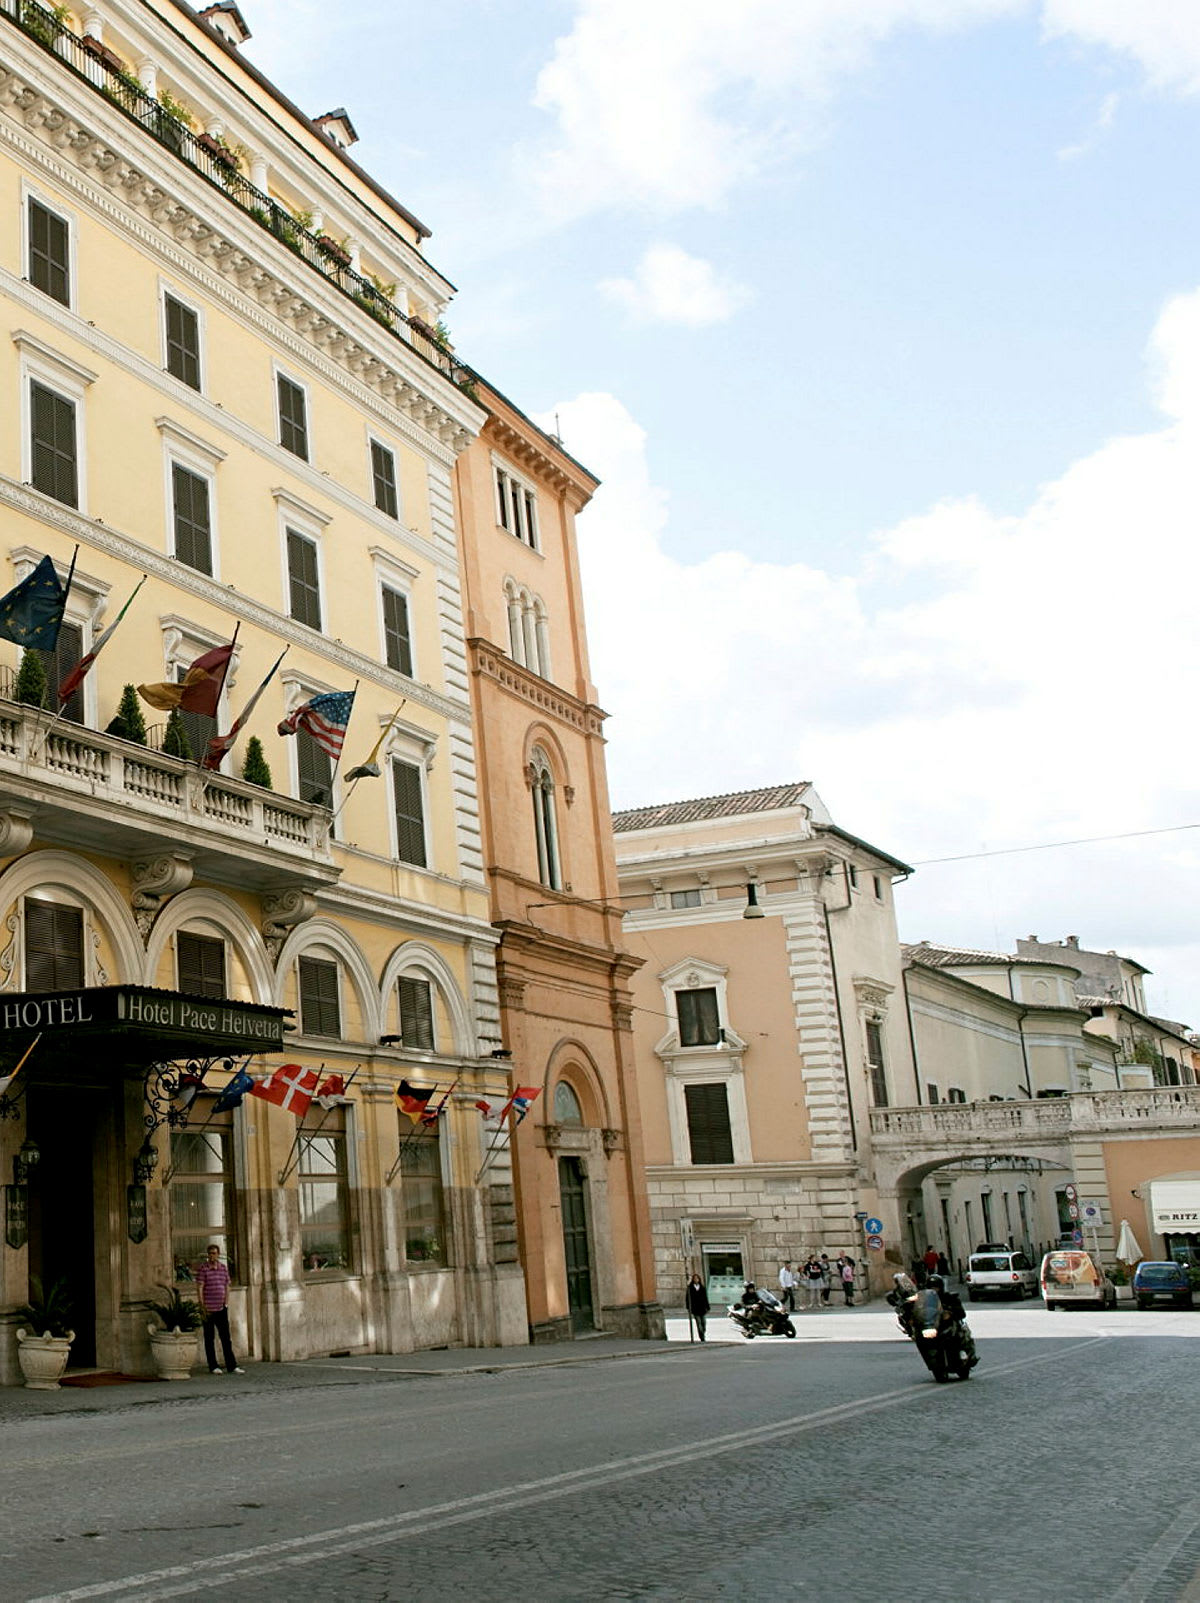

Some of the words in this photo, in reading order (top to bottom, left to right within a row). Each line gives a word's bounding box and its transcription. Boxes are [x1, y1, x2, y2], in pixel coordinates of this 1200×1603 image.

[3, 996, 93, 1029] HOTEL
[129, 994, 174, 1025] Hotel
[180, 1001, 217, 1031] Pace
[221, 1008, 280, 1039] Helvetia
